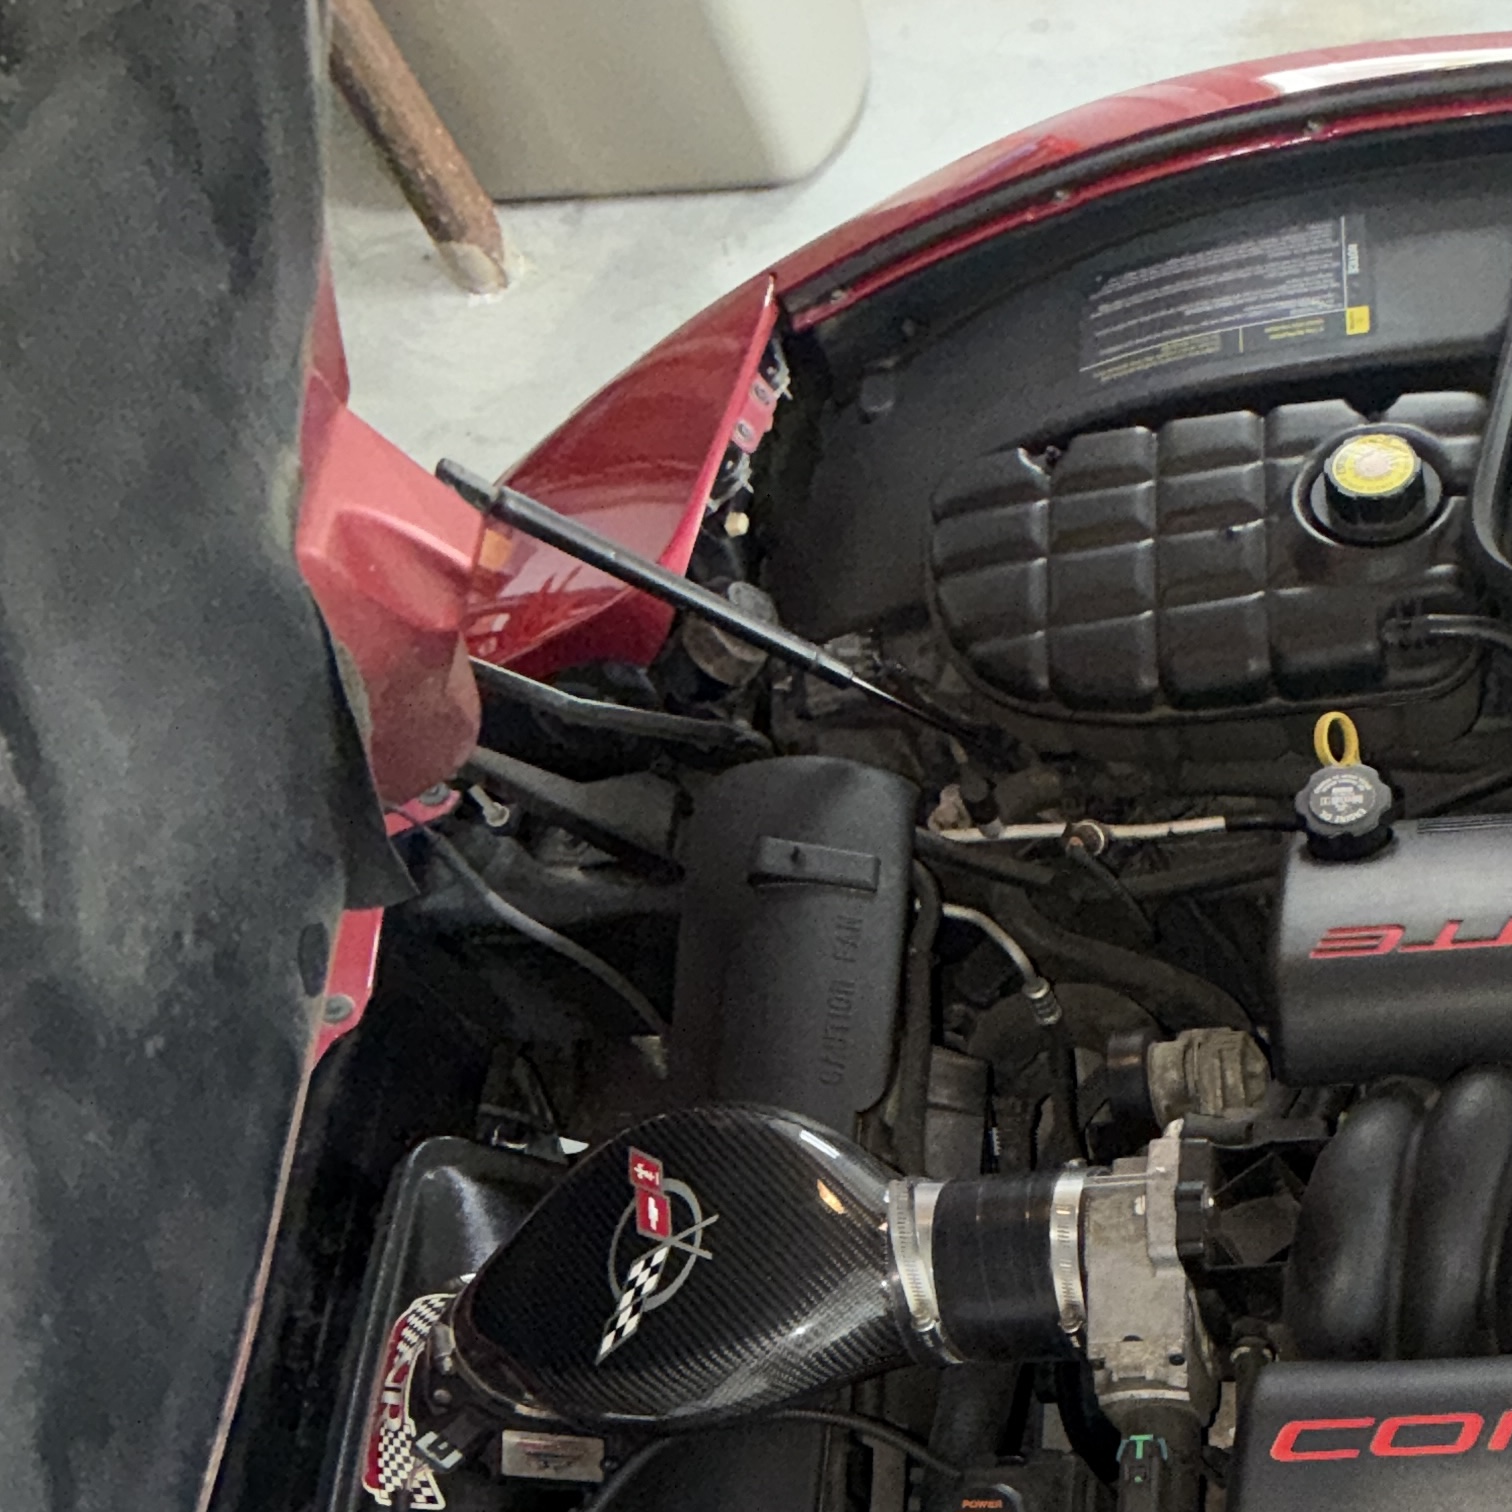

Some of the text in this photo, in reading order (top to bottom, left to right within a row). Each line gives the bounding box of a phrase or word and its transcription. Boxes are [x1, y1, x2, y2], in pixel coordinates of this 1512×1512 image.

[818, 914, 862, 1086] CAUTION FAN
[962, 1499, 1003, 1508] POWER
